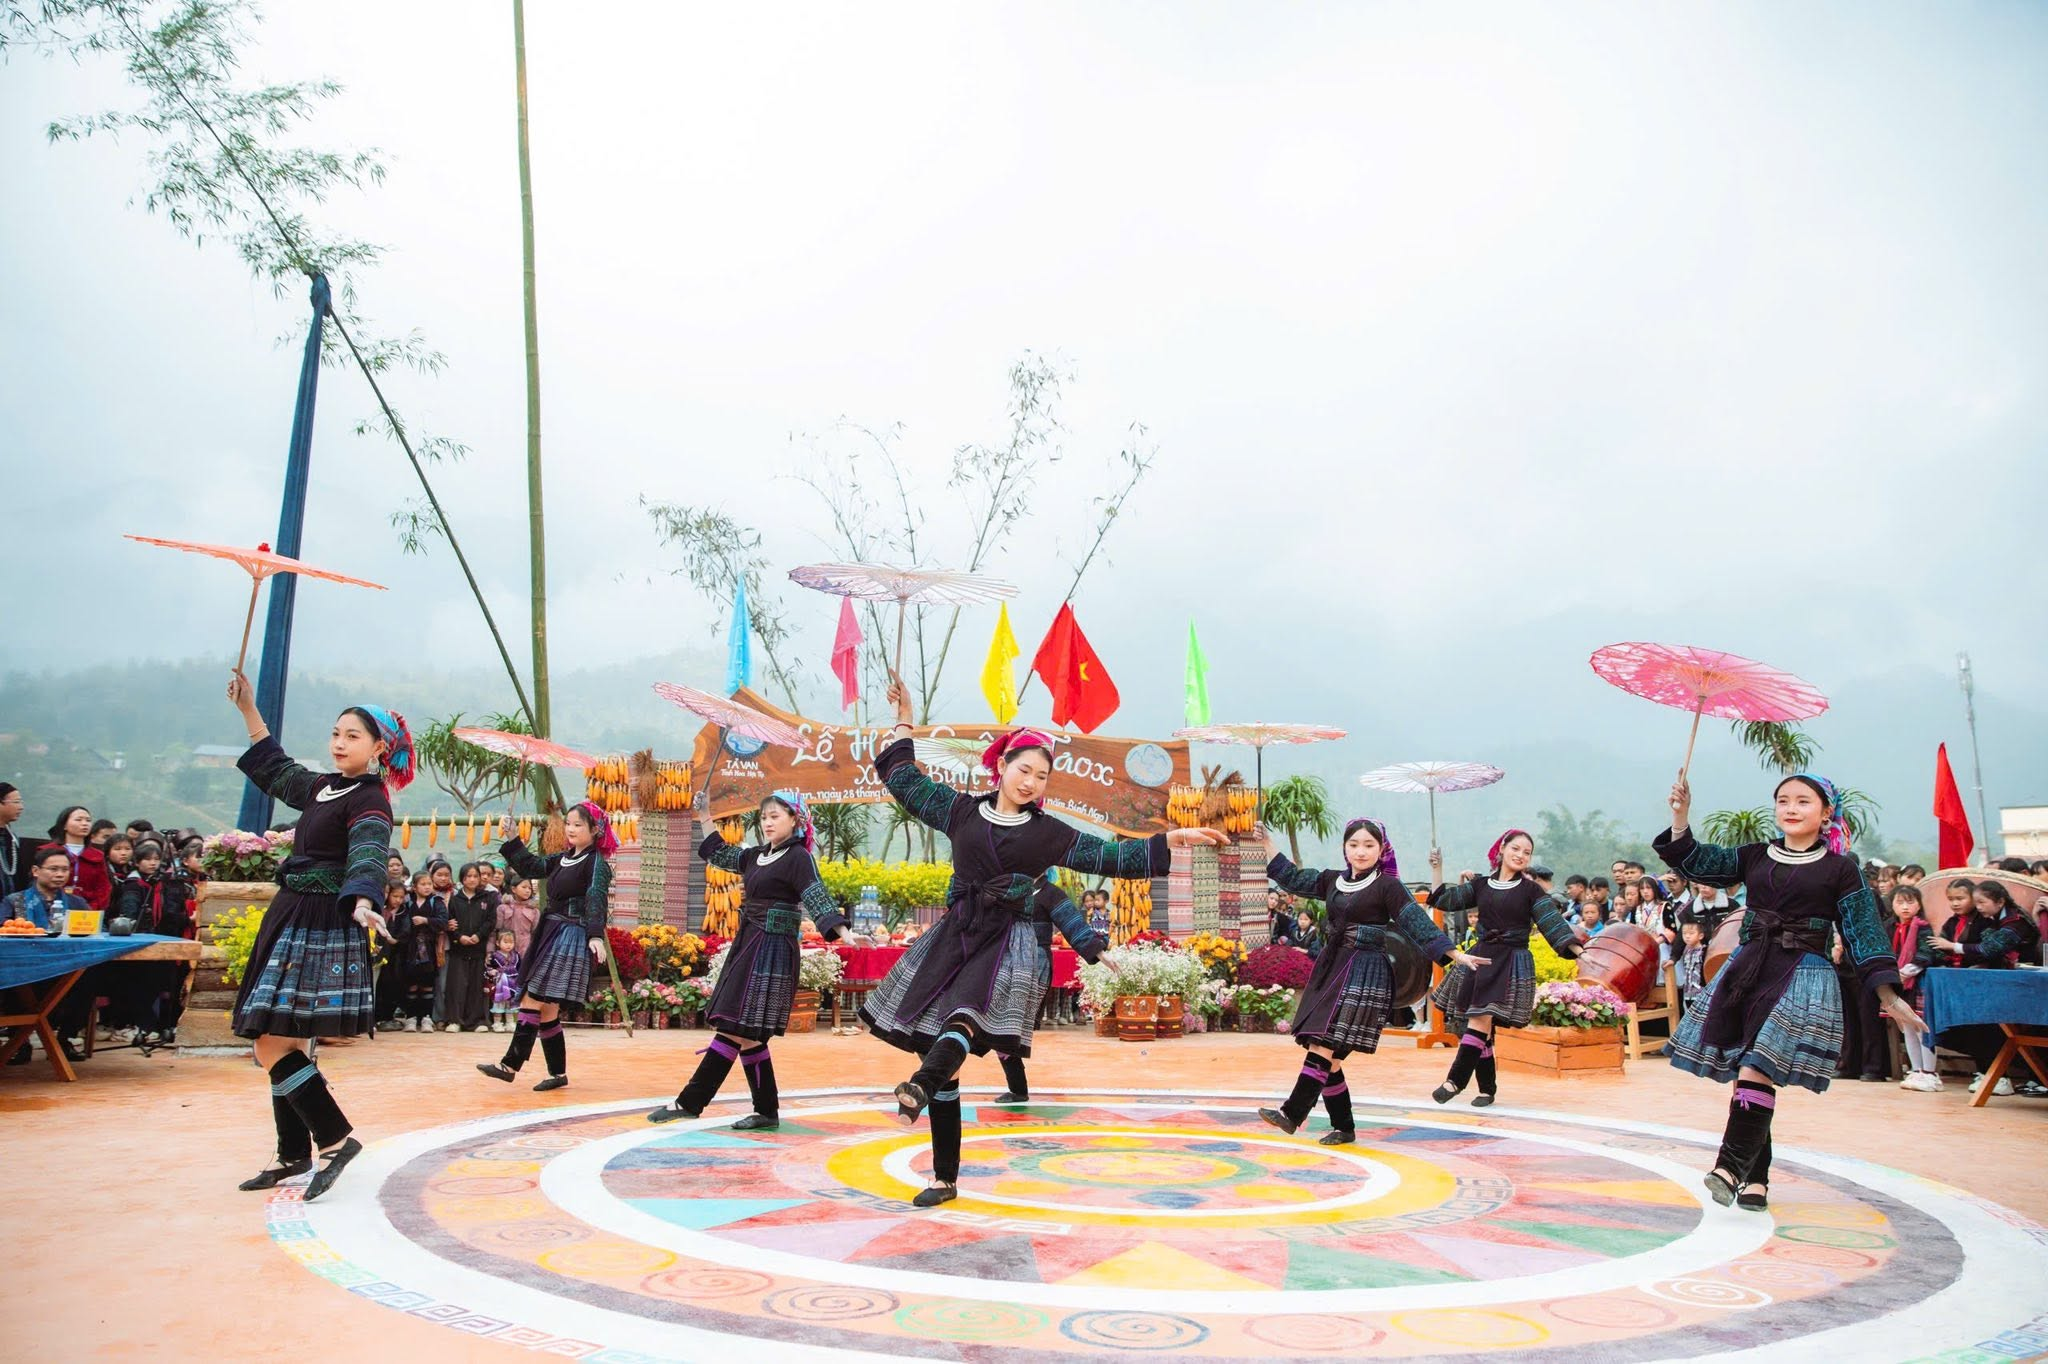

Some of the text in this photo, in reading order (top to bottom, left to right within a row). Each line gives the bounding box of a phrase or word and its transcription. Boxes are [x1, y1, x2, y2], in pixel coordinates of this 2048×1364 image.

[790, 723, 841, 766] Lễ
[726, 758, 759, 770] TẢ VAN
[816, 786, 842, 803] ngày
[843, 788, 855, 799] 28
[855, 786, 881, 803] tháng
